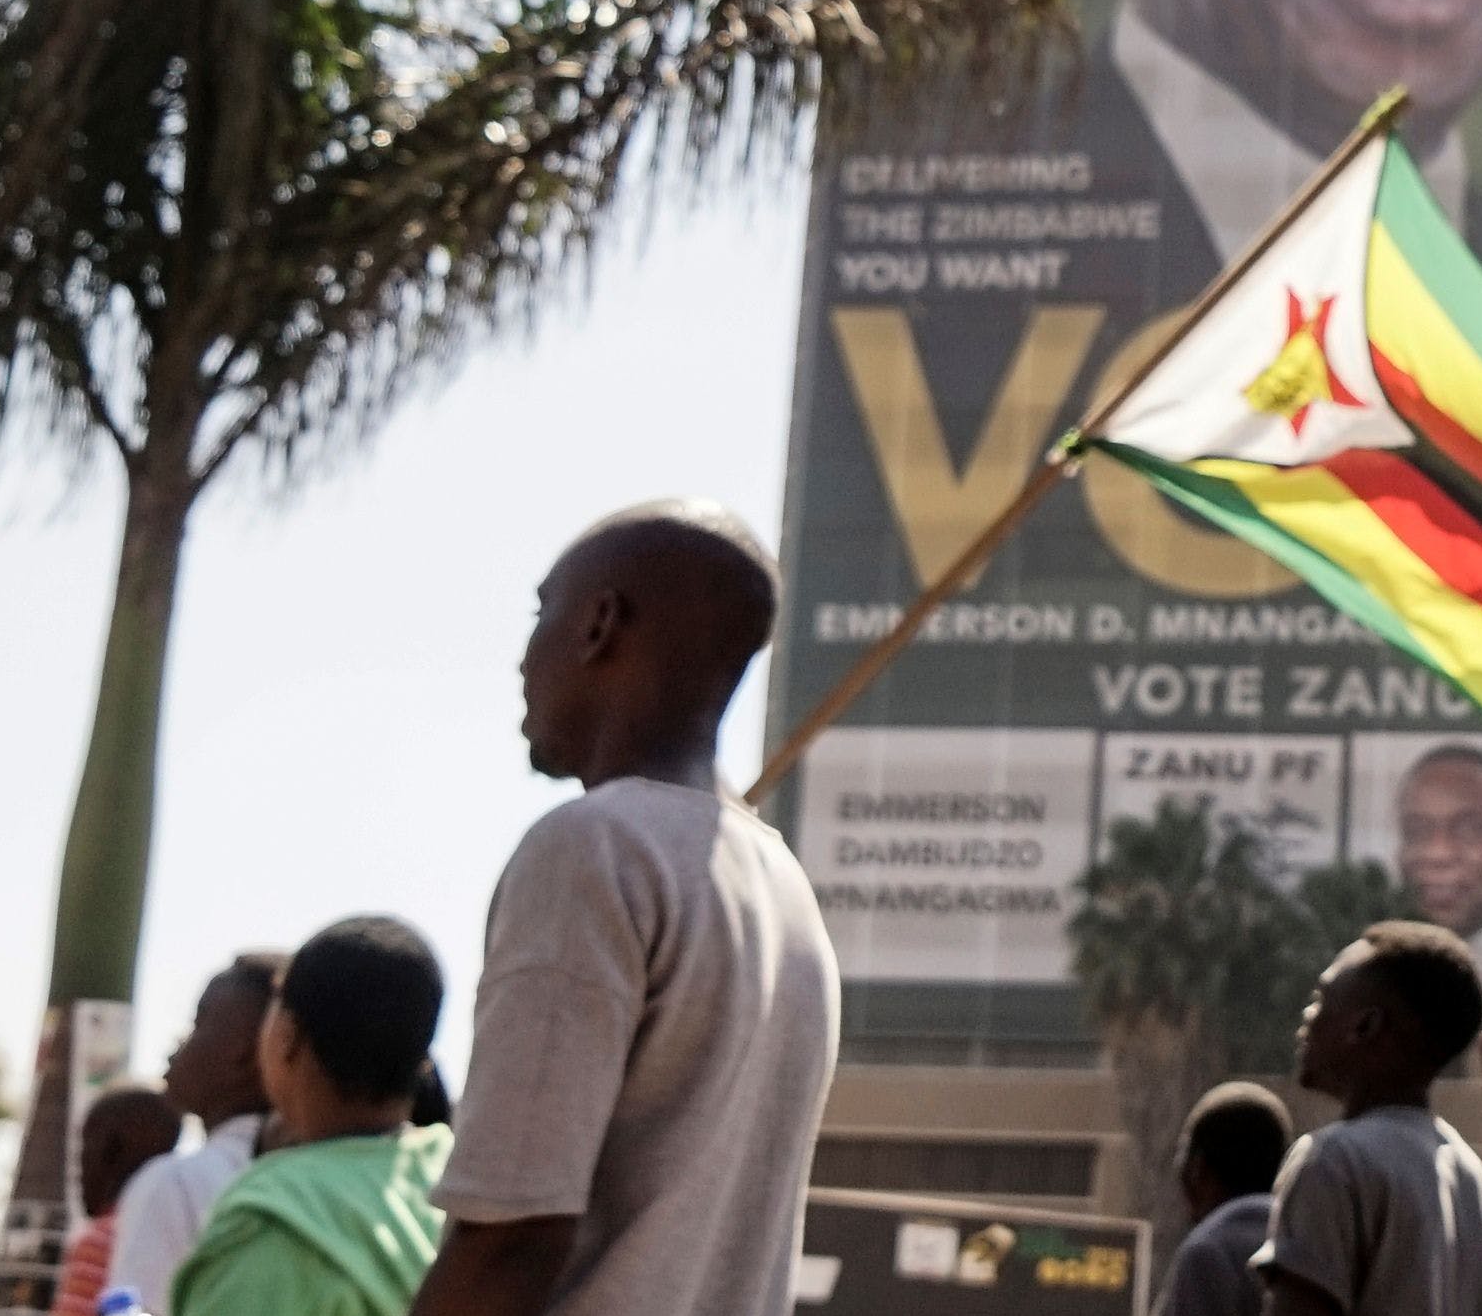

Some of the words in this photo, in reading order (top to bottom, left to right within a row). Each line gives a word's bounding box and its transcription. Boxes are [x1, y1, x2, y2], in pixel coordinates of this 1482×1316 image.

[841, 155, 1092, 192] DELIVERING
[843, 204, 921, 241] THE
[933, 201, 1163, 240] ZIMBABWE
[839, 252, 928, 290] YOU
[938, 248, 1065, 289] WANT
[1096, 666, 1261, 717] VOTE
[1125, 748, 1253, 782] ZANU
[1270, 751, 1324, 784] PF
[838, 792, 1046, 823] EMMERSON
[836, 838, 1044, 869] DAMBUDZO
